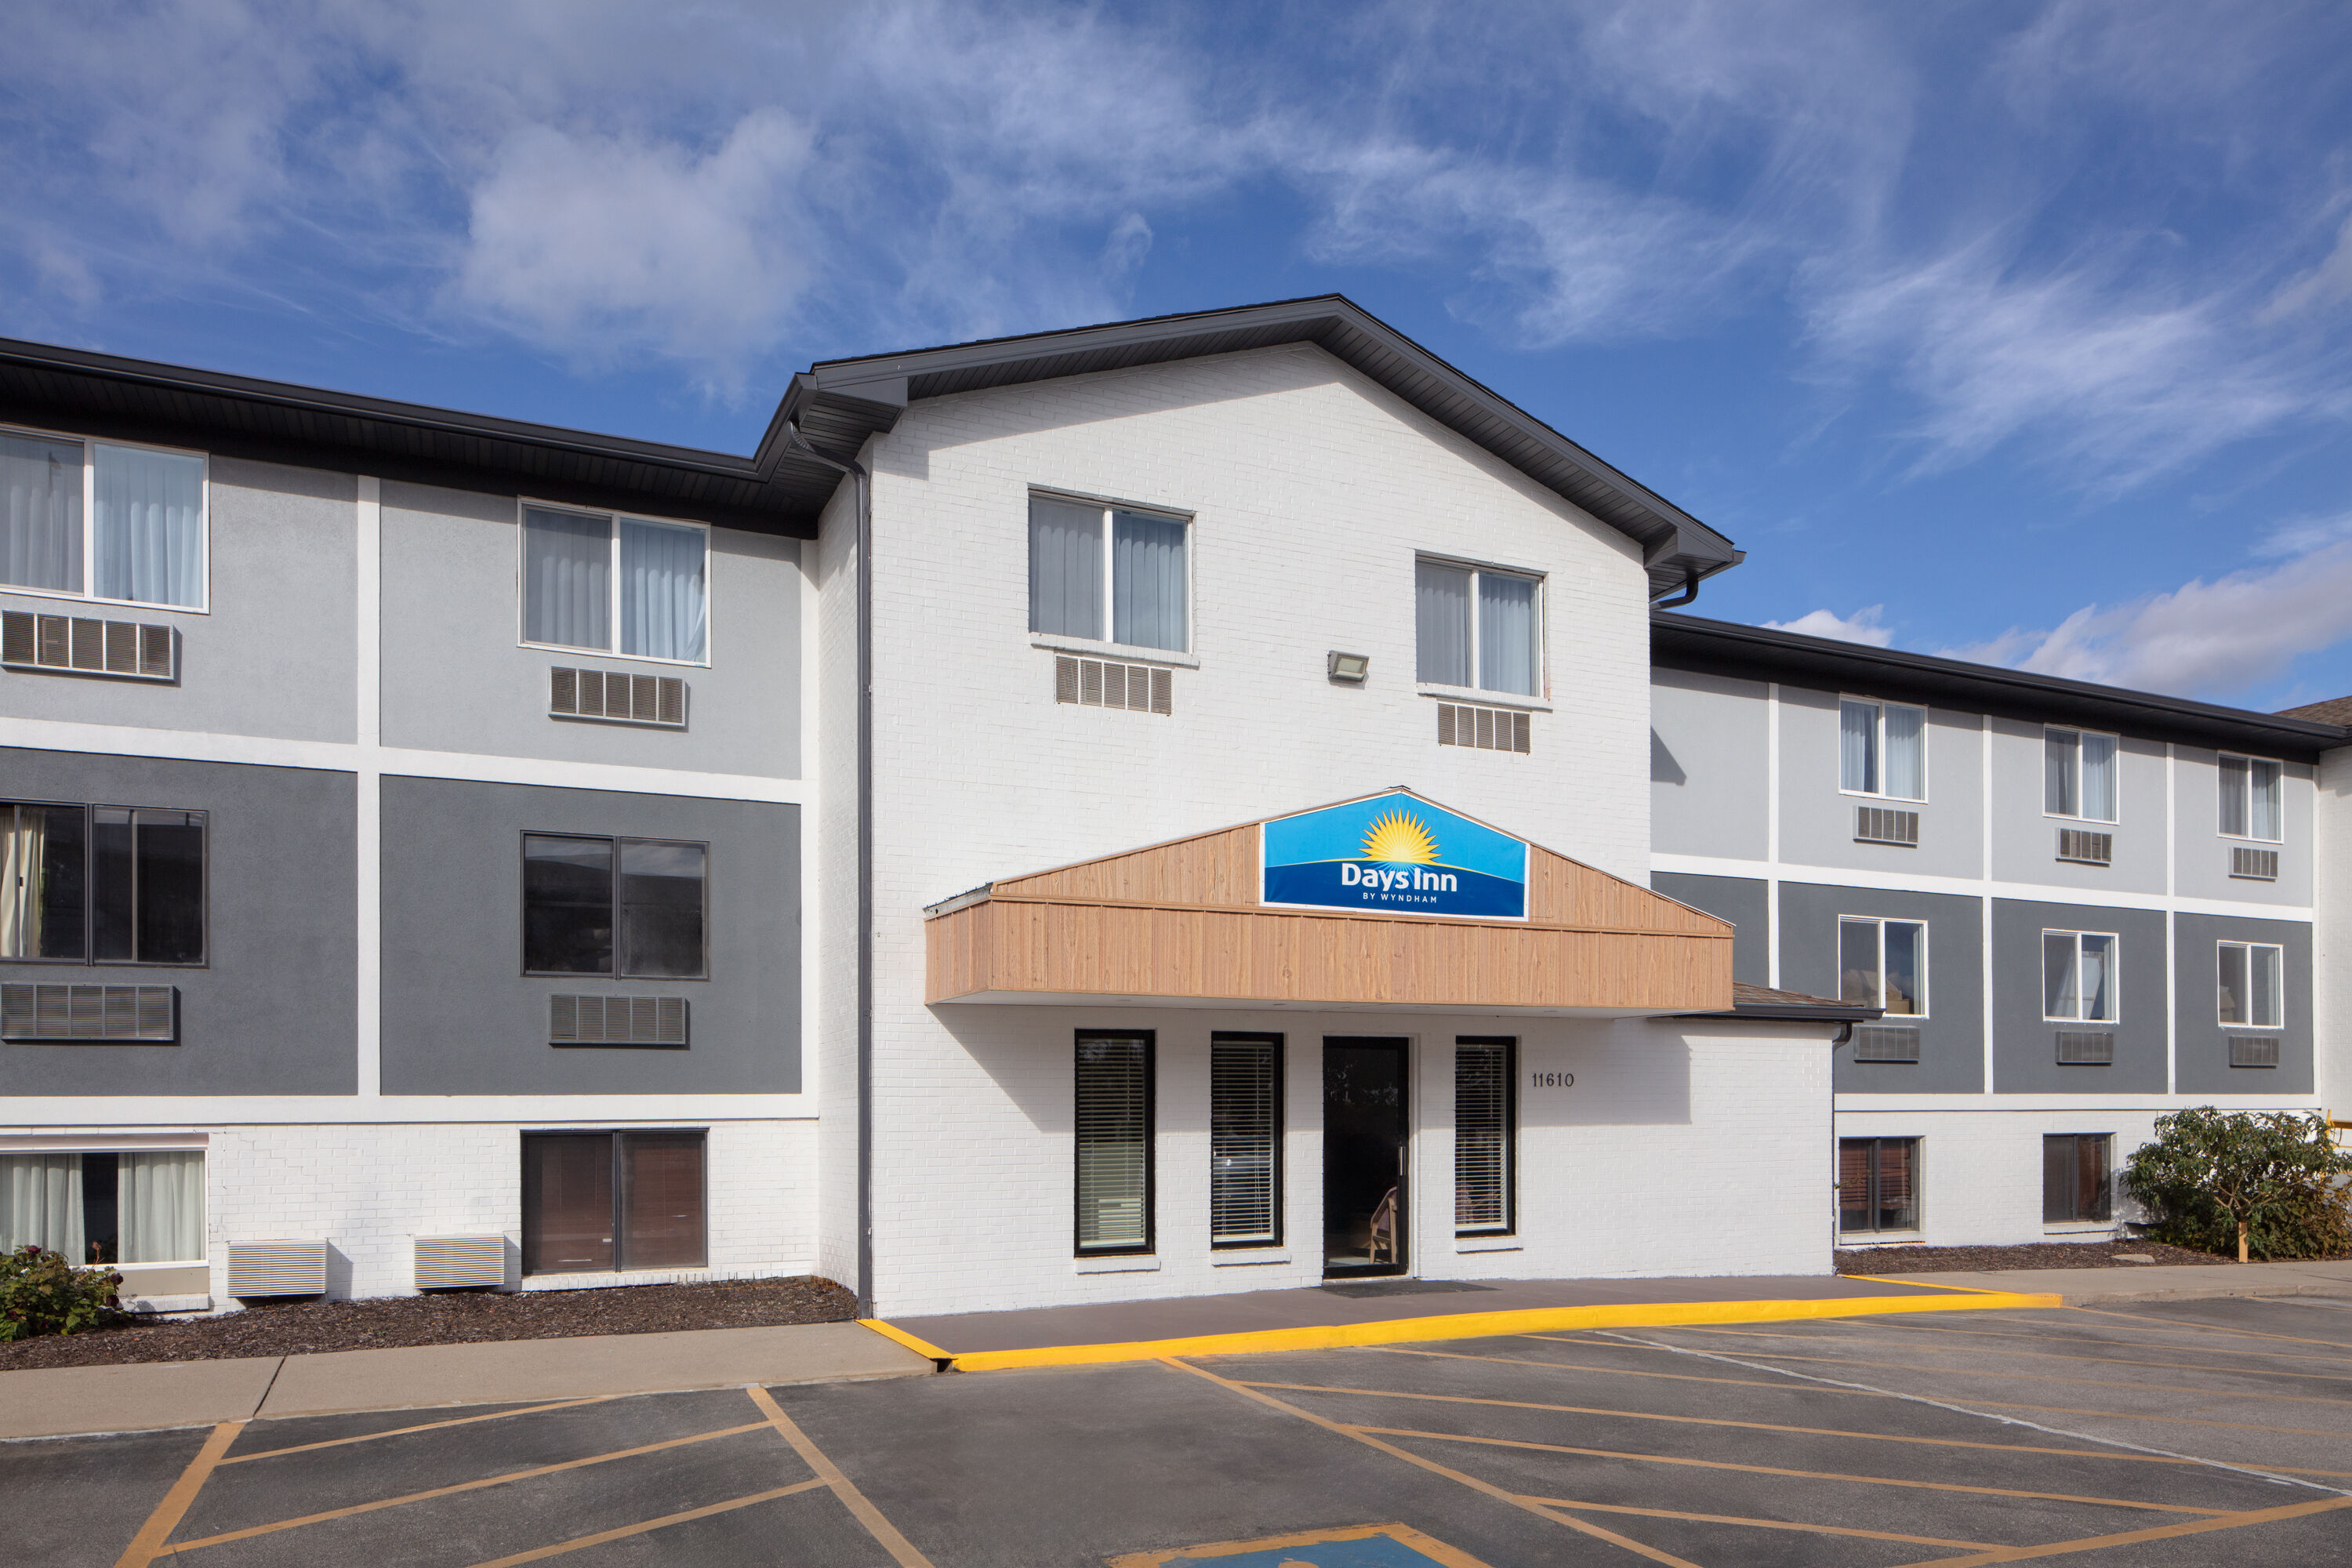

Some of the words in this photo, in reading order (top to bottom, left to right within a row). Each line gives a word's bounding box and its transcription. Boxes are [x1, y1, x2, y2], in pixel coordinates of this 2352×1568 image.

[1341, 863, 1409, 891] Days
[1414, 868, 1457, 891] Inn
[1381, 893, 1437, 903] WYNDHAM
[1532, 1073, 1574, 1087] 11610
